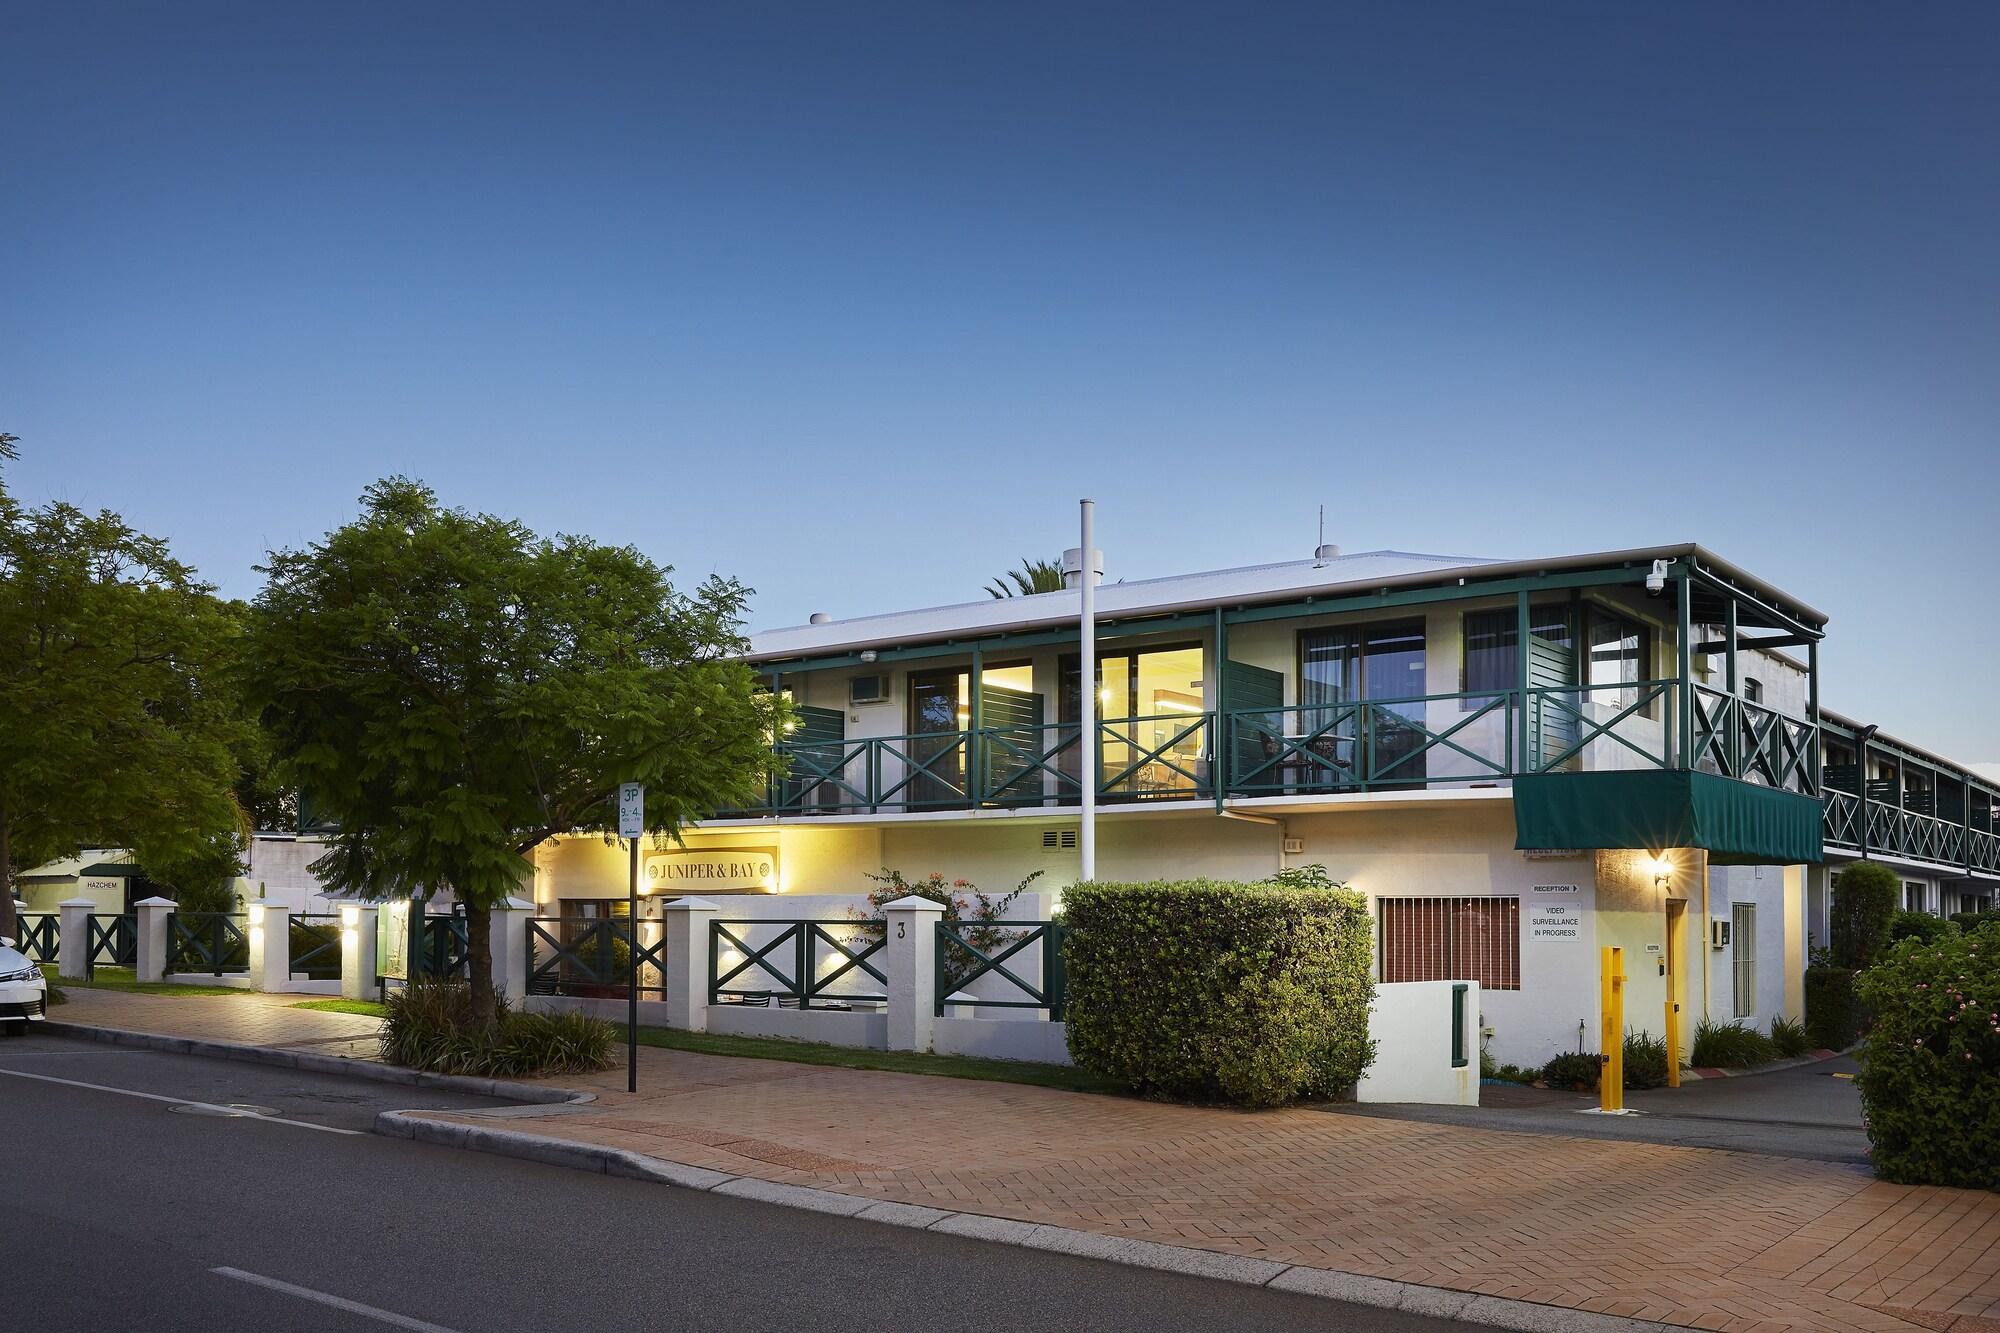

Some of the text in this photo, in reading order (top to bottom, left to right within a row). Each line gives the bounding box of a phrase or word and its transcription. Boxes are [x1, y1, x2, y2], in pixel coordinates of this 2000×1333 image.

[624, 789, 639, 802] 3P
[661, 862, 756, 879] JUNIPER & BAY
[1532, 918, 1579, 926] SURVEILLANCE
[897, 921, 906, 939] 3
[1542, 929, 1577, 937] PROGRESS
